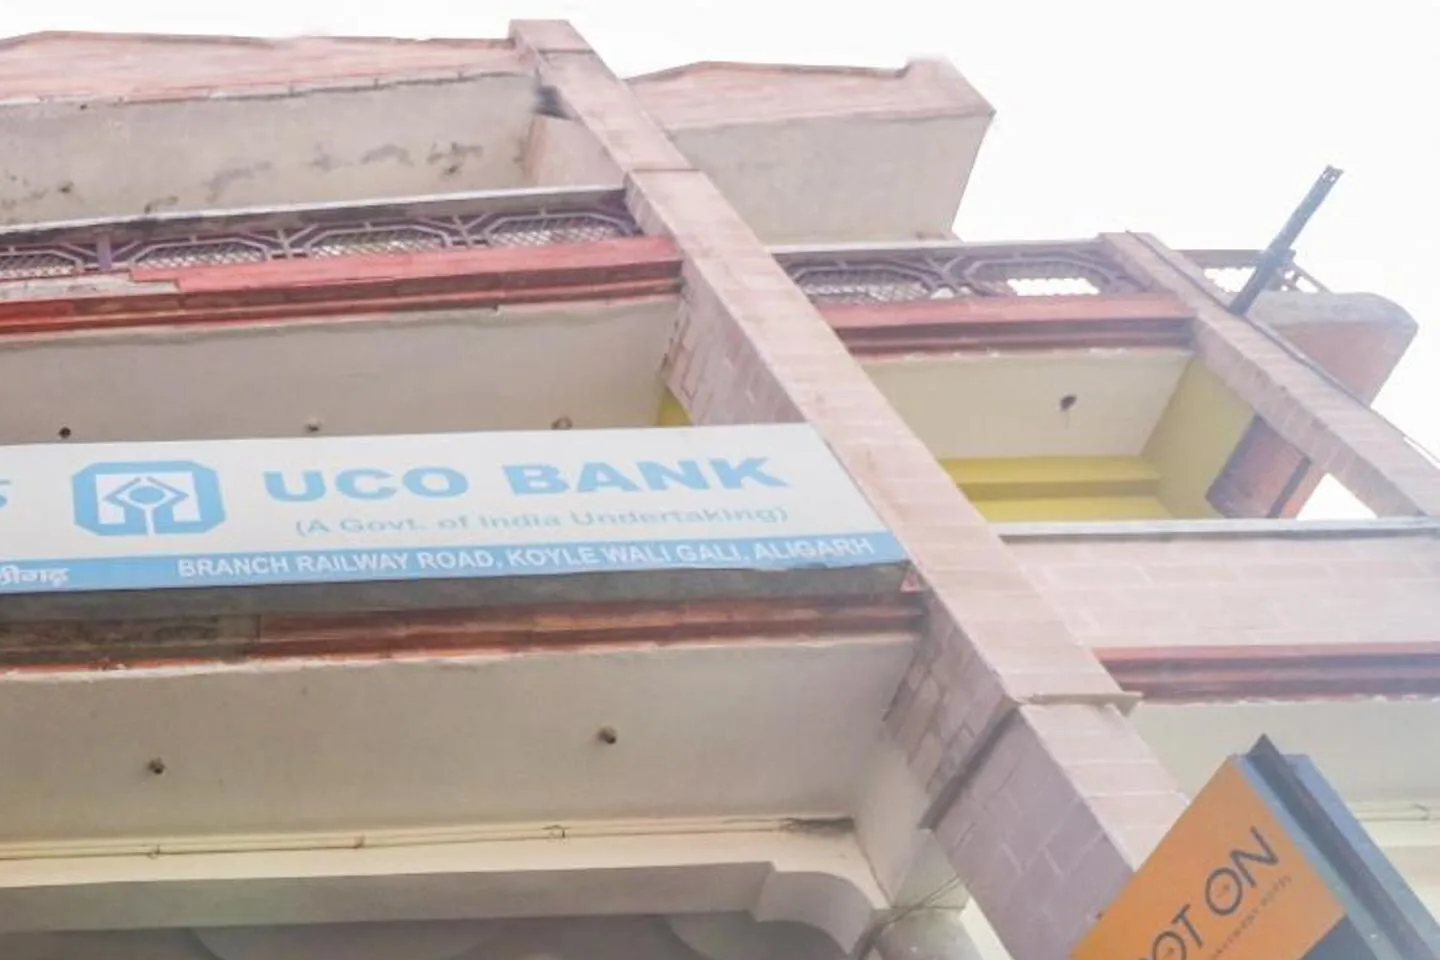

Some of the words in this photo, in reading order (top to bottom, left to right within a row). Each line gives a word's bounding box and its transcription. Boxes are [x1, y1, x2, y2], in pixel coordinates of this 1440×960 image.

[262, 466, 469, 502] UCO
[501, 456, 792, 496] BANK
[295, 518, 330, 537] (A
[340, 516, 426, 534] Govt.
[437, 513, 467, 530] of
[480, 508, 561, 529] India
[570, 503, 789, 528] Undertaking)
[177, 555, 289, 579] BRANCH
[296, 551, 410, 574] RAILWAY
[416, 547, 502, 571] ROAD,
[509, 545, 599, 568] KOYLE
[597, 542, 672, 565] WALI
[754, 536, 876, 561] ALIGARH
[1205, 825, 1279, 916] ON
